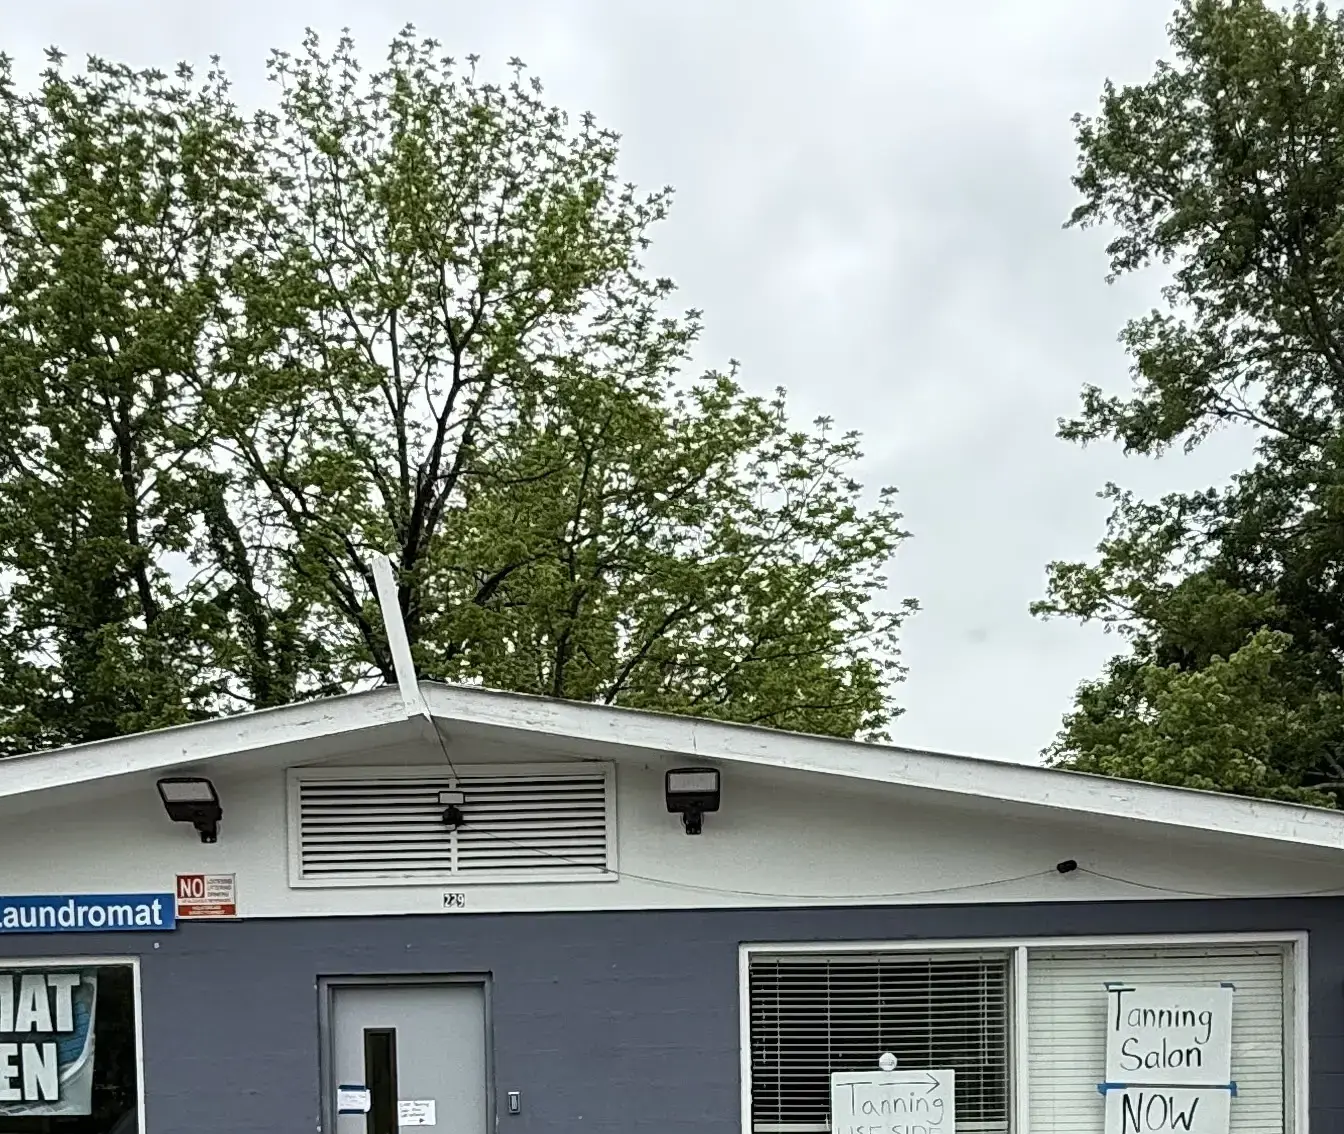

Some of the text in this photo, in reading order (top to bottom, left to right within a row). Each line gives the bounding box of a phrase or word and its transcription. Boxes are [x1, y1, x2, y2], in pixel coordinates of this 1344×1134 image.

[180, 878, 204, 898] NO
[1108, 987, 1213, 1045] Tanning
[1120, 1037, 1202, 1072] Salon
[835, 1082, 945, 1126] Tanning
